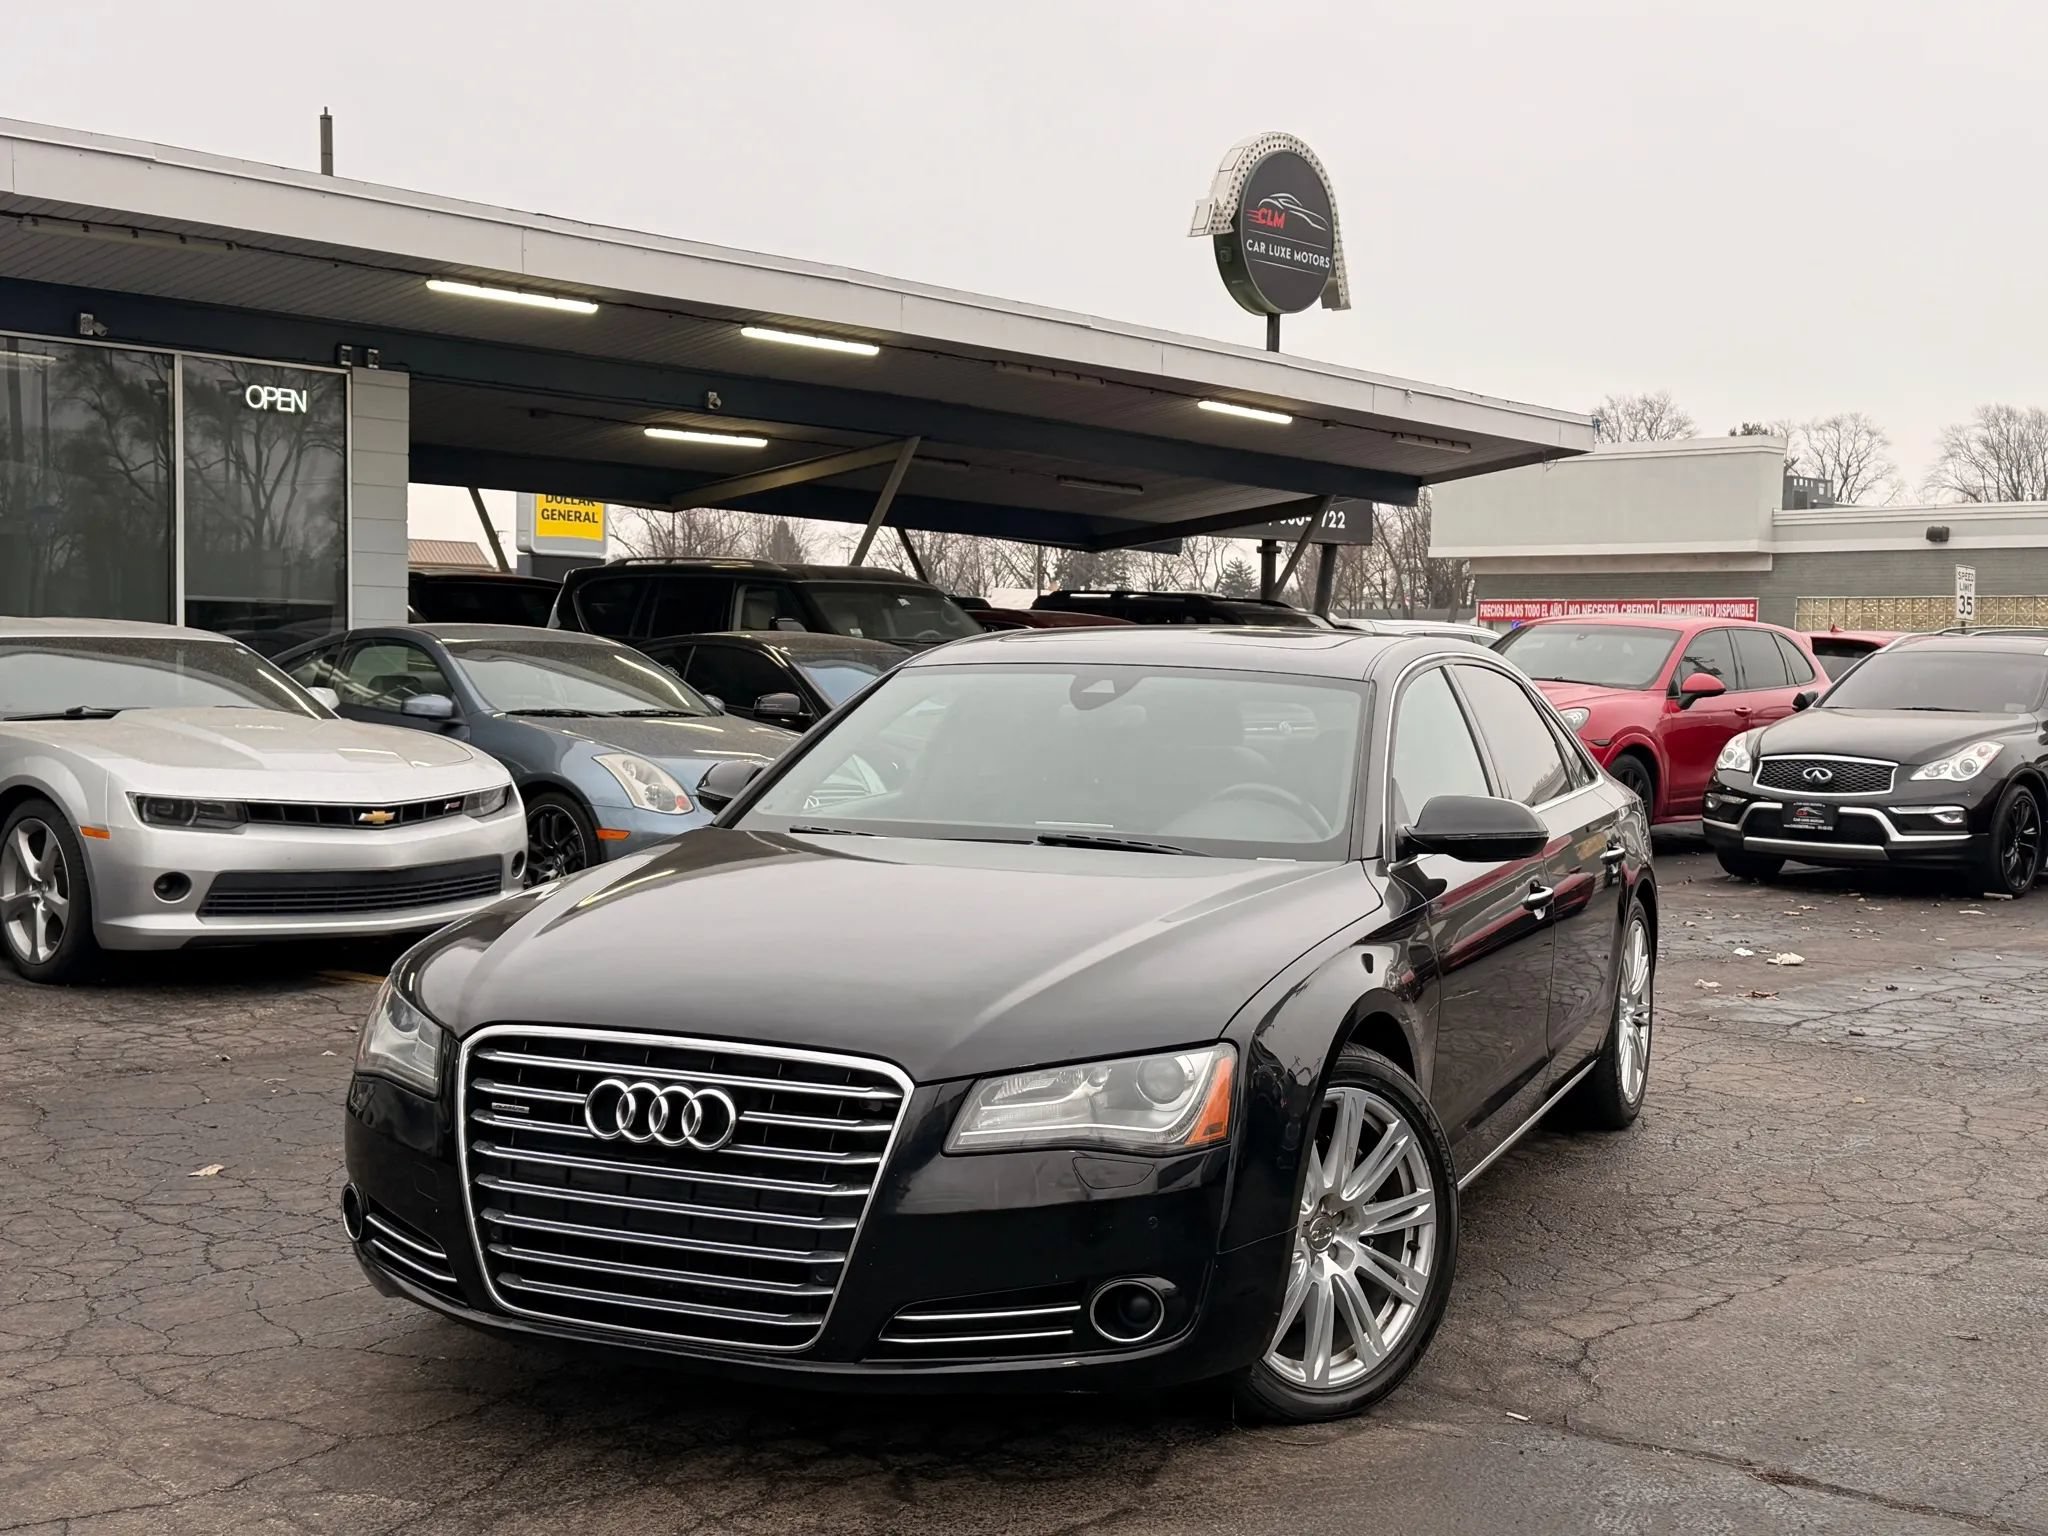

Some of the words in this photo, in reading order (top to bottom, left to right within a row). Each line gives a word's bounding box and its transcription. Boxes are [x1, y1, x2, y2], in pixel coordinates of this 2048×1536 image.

[1257, 208, 1285, 229] CLM
[1246, 240, 1266, 254] CAR
[1269, 244, 1291, 260] LUXE
[1294, 250, 1330, 268] MOTORS
[246, 385, 307, 413] OPEN
[541, 508, 599, 523] GENERAL
[1479, 603, 1504, 618] PRECIOS
[1505, 603, 1524, 618] BAJOS
[1525, 603, 1541, 618] TODO
[1541, 603, 1549, 617] EL
[1549, 602, 1563, 617] AÑO
[1569, 603, 1581, 615] NO
[1582, 603, 1619, 615] NECESITA
[1620, 603, 1656, 615] CREDITO
[1661, 603, 1714, 617] FINANCIAMIENTO
[1715, 603, 1754, 618] DISPONIBLE
[1958, 595, 1973, 616] 35
